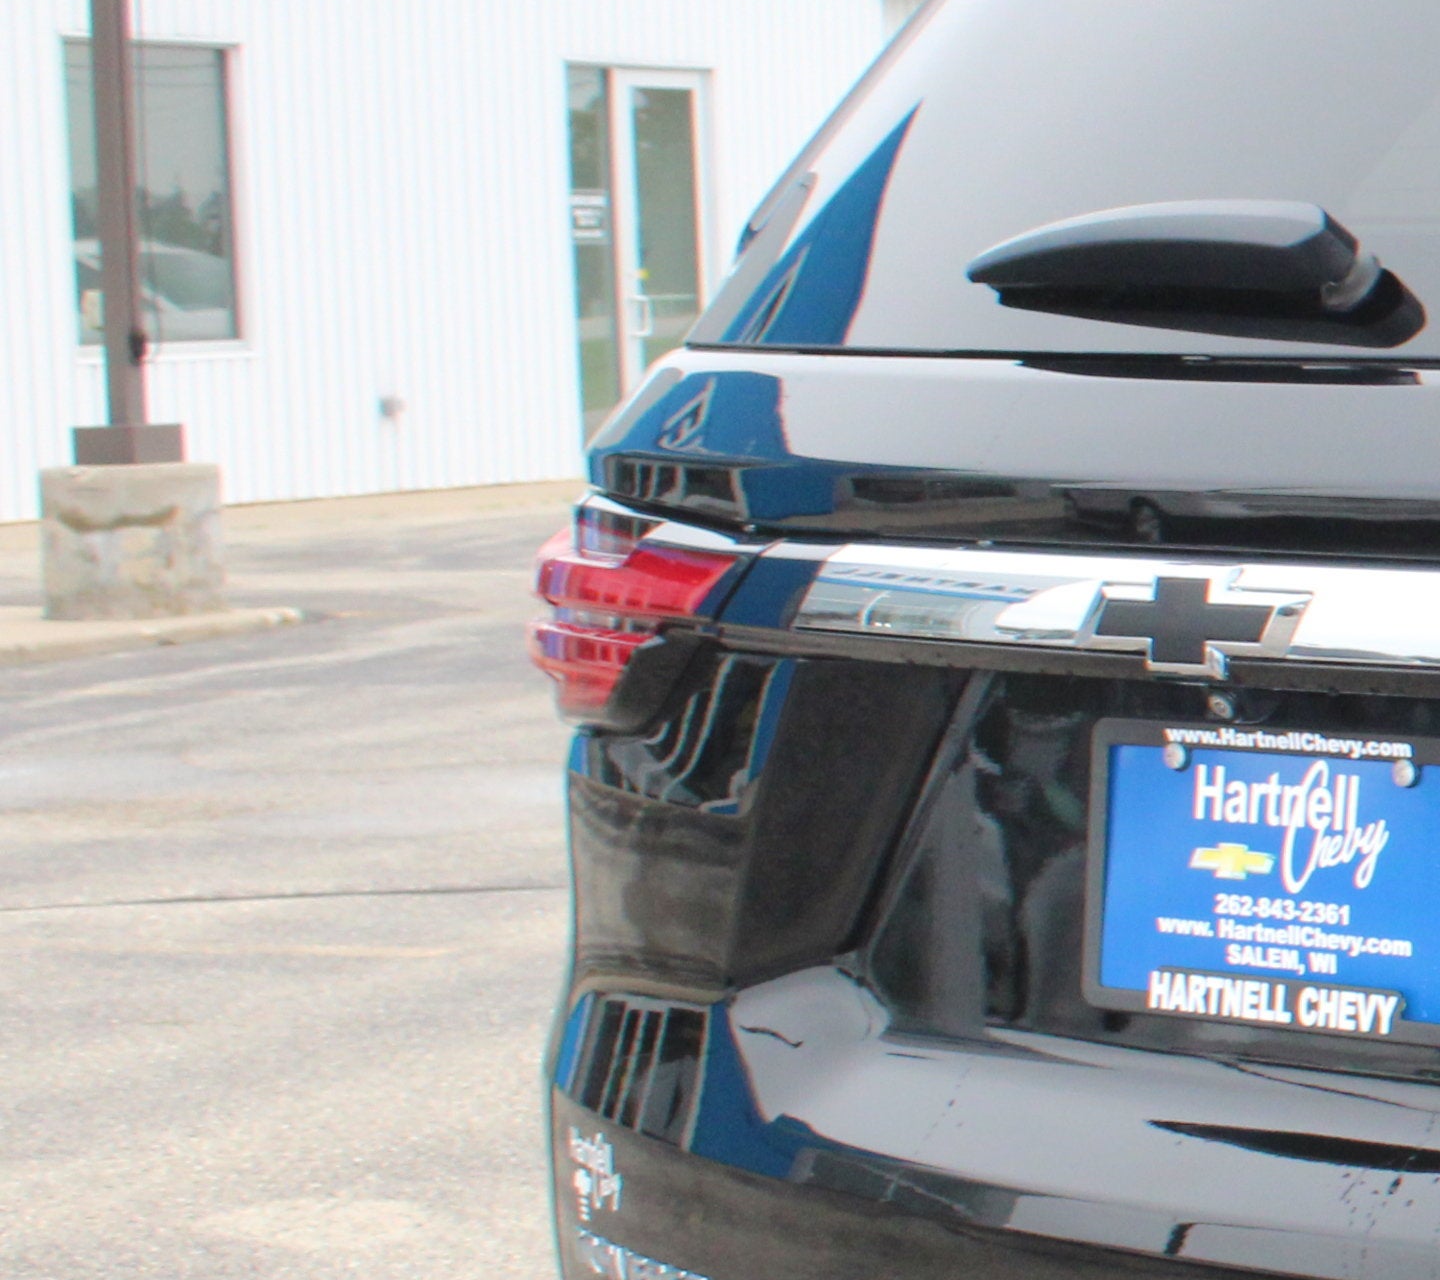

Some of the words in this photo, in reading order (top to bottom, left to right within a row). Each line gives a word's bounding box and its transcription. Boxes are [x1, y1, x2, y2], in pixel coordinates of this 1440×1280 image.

[1163, 726, 1413, 759] www.HartnellChevy.com
[1193, 762, 1360, 832] Hartnell
[1280, 758, 1389, 894] Chevy
[1214, 893, 1350, 926] 262-843-2361
[1226, 942, 1306, 976] SALEM,
[1310, 952, 1338, 974] WI
[1148, 970, 1292, 1024] HARTNELL
[1298, 986, 1398, 1035] CHEVY
